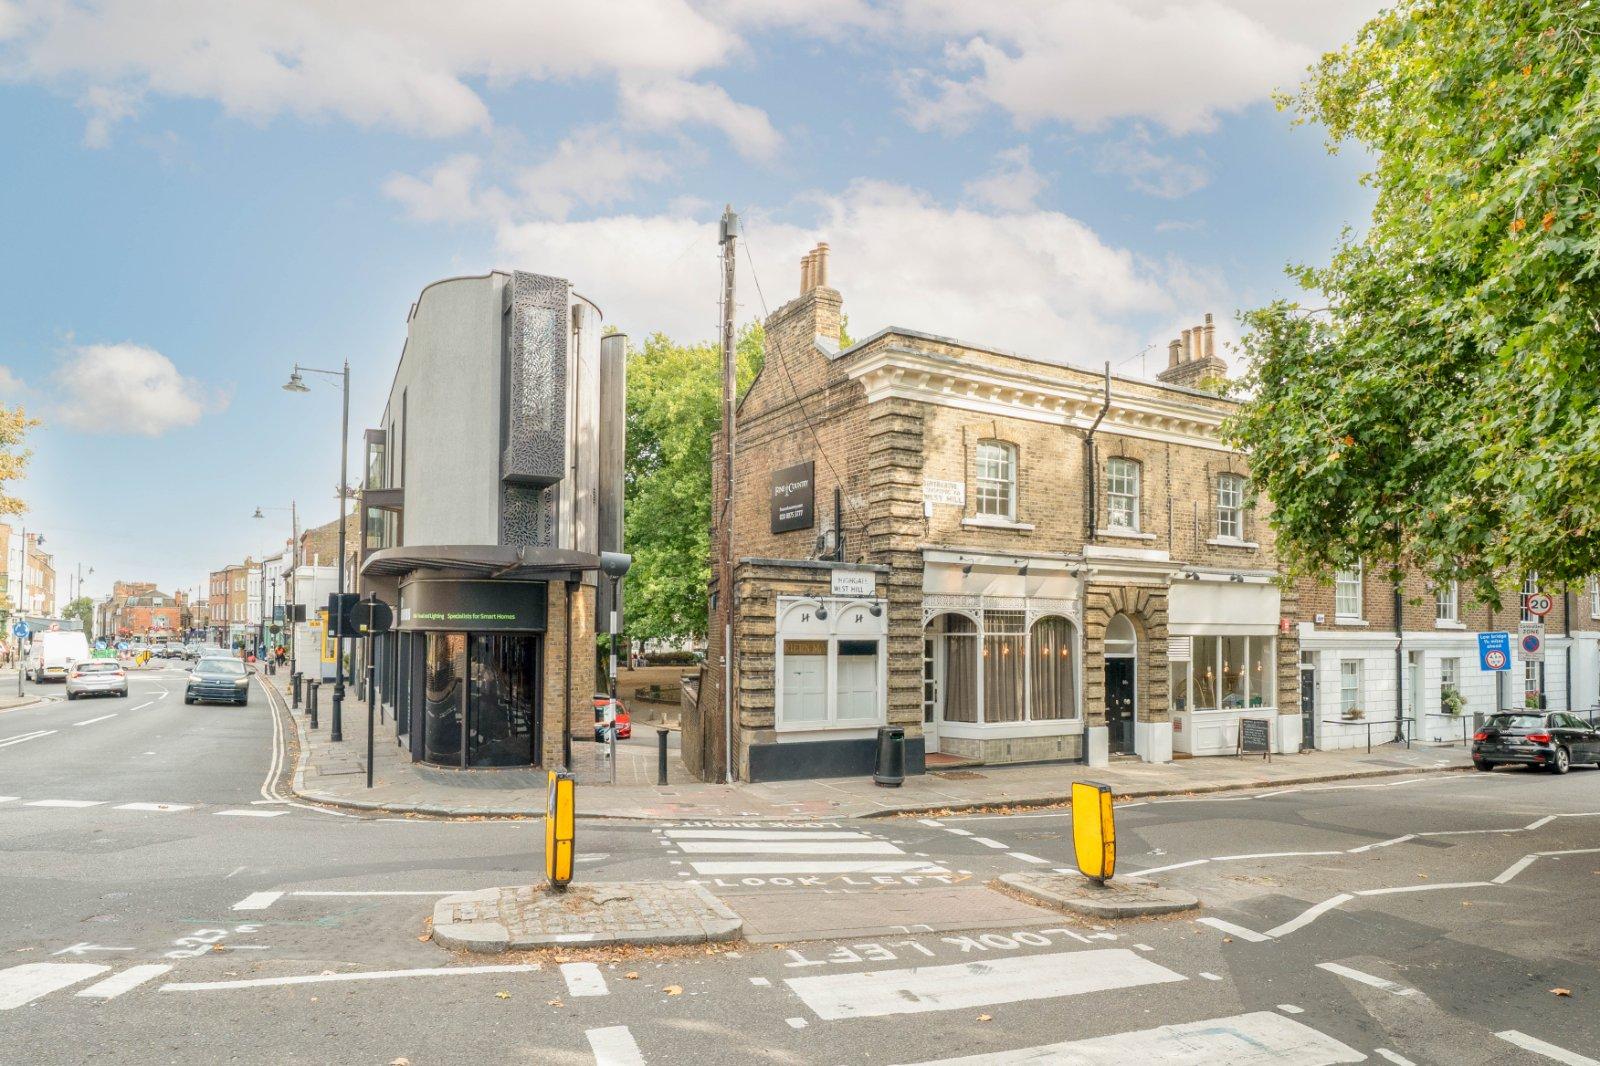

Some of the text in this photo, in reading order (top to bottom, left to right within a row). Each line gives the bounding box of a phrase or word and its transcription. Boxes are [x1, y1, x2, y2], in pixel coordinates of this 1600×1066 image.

[1531, 599, 1548, 609] 20
[712, 875, 953, 888] LOOK LEFT
[783, 928, 1093, 968] LOOK LEFT
